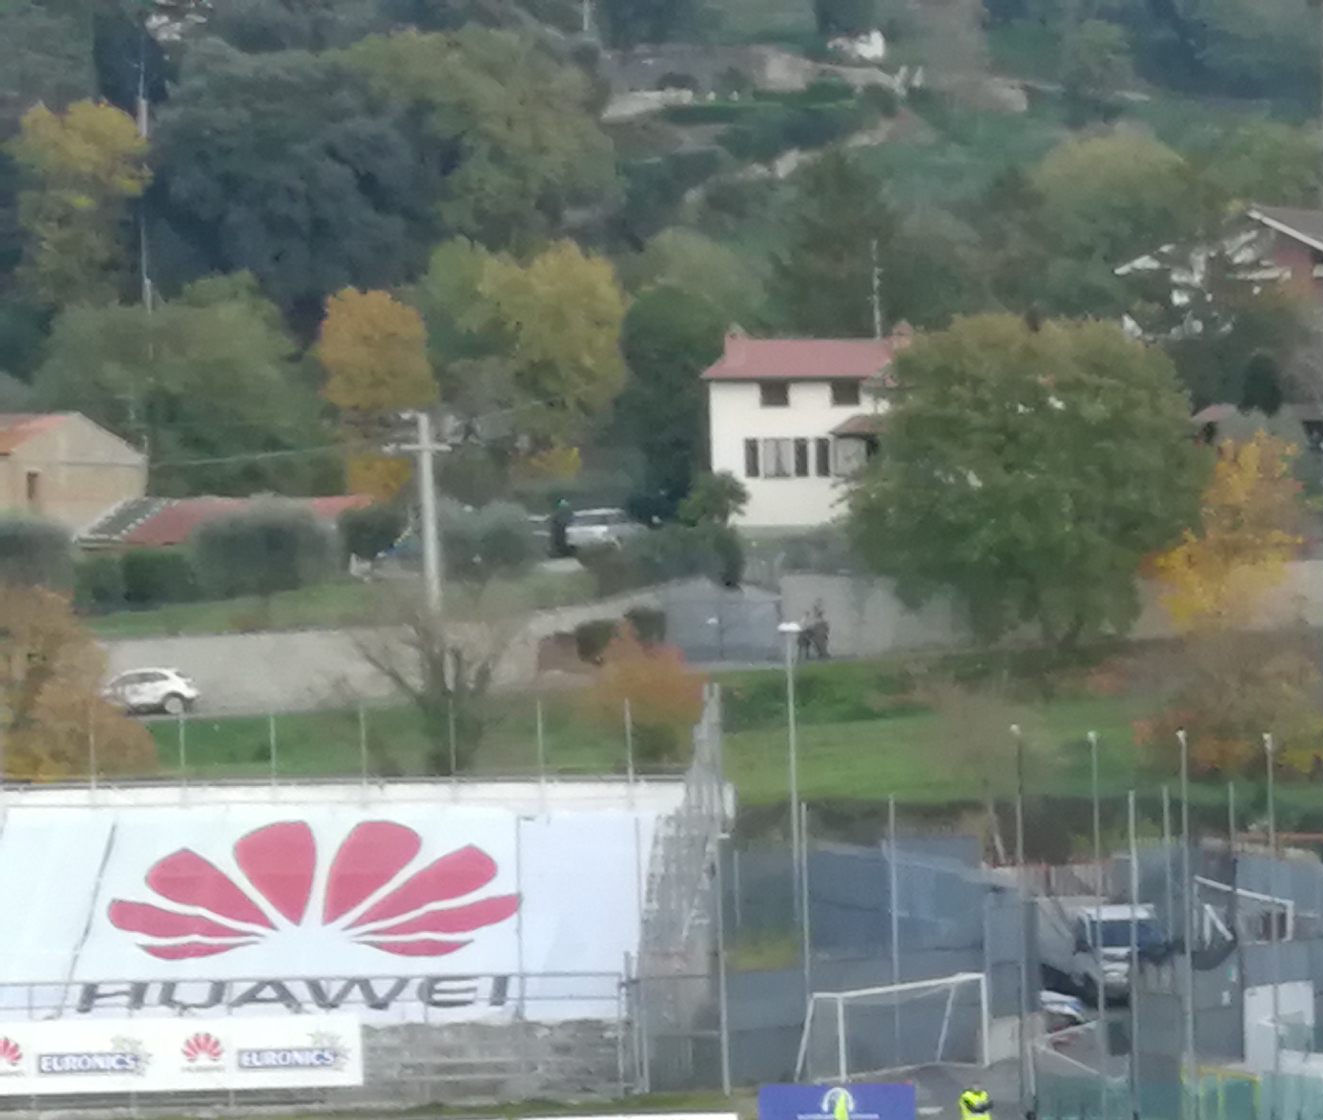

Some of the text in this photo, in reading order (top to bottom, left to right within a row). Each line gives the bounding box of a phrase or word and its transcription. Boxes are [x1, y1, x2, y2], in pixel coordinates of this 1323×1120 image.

[76, 975, 513, 1013] HUAWEI
[40, 1054, 138, 1074] EURONICS
[240, 1049, 337, 1069] EURONICS
